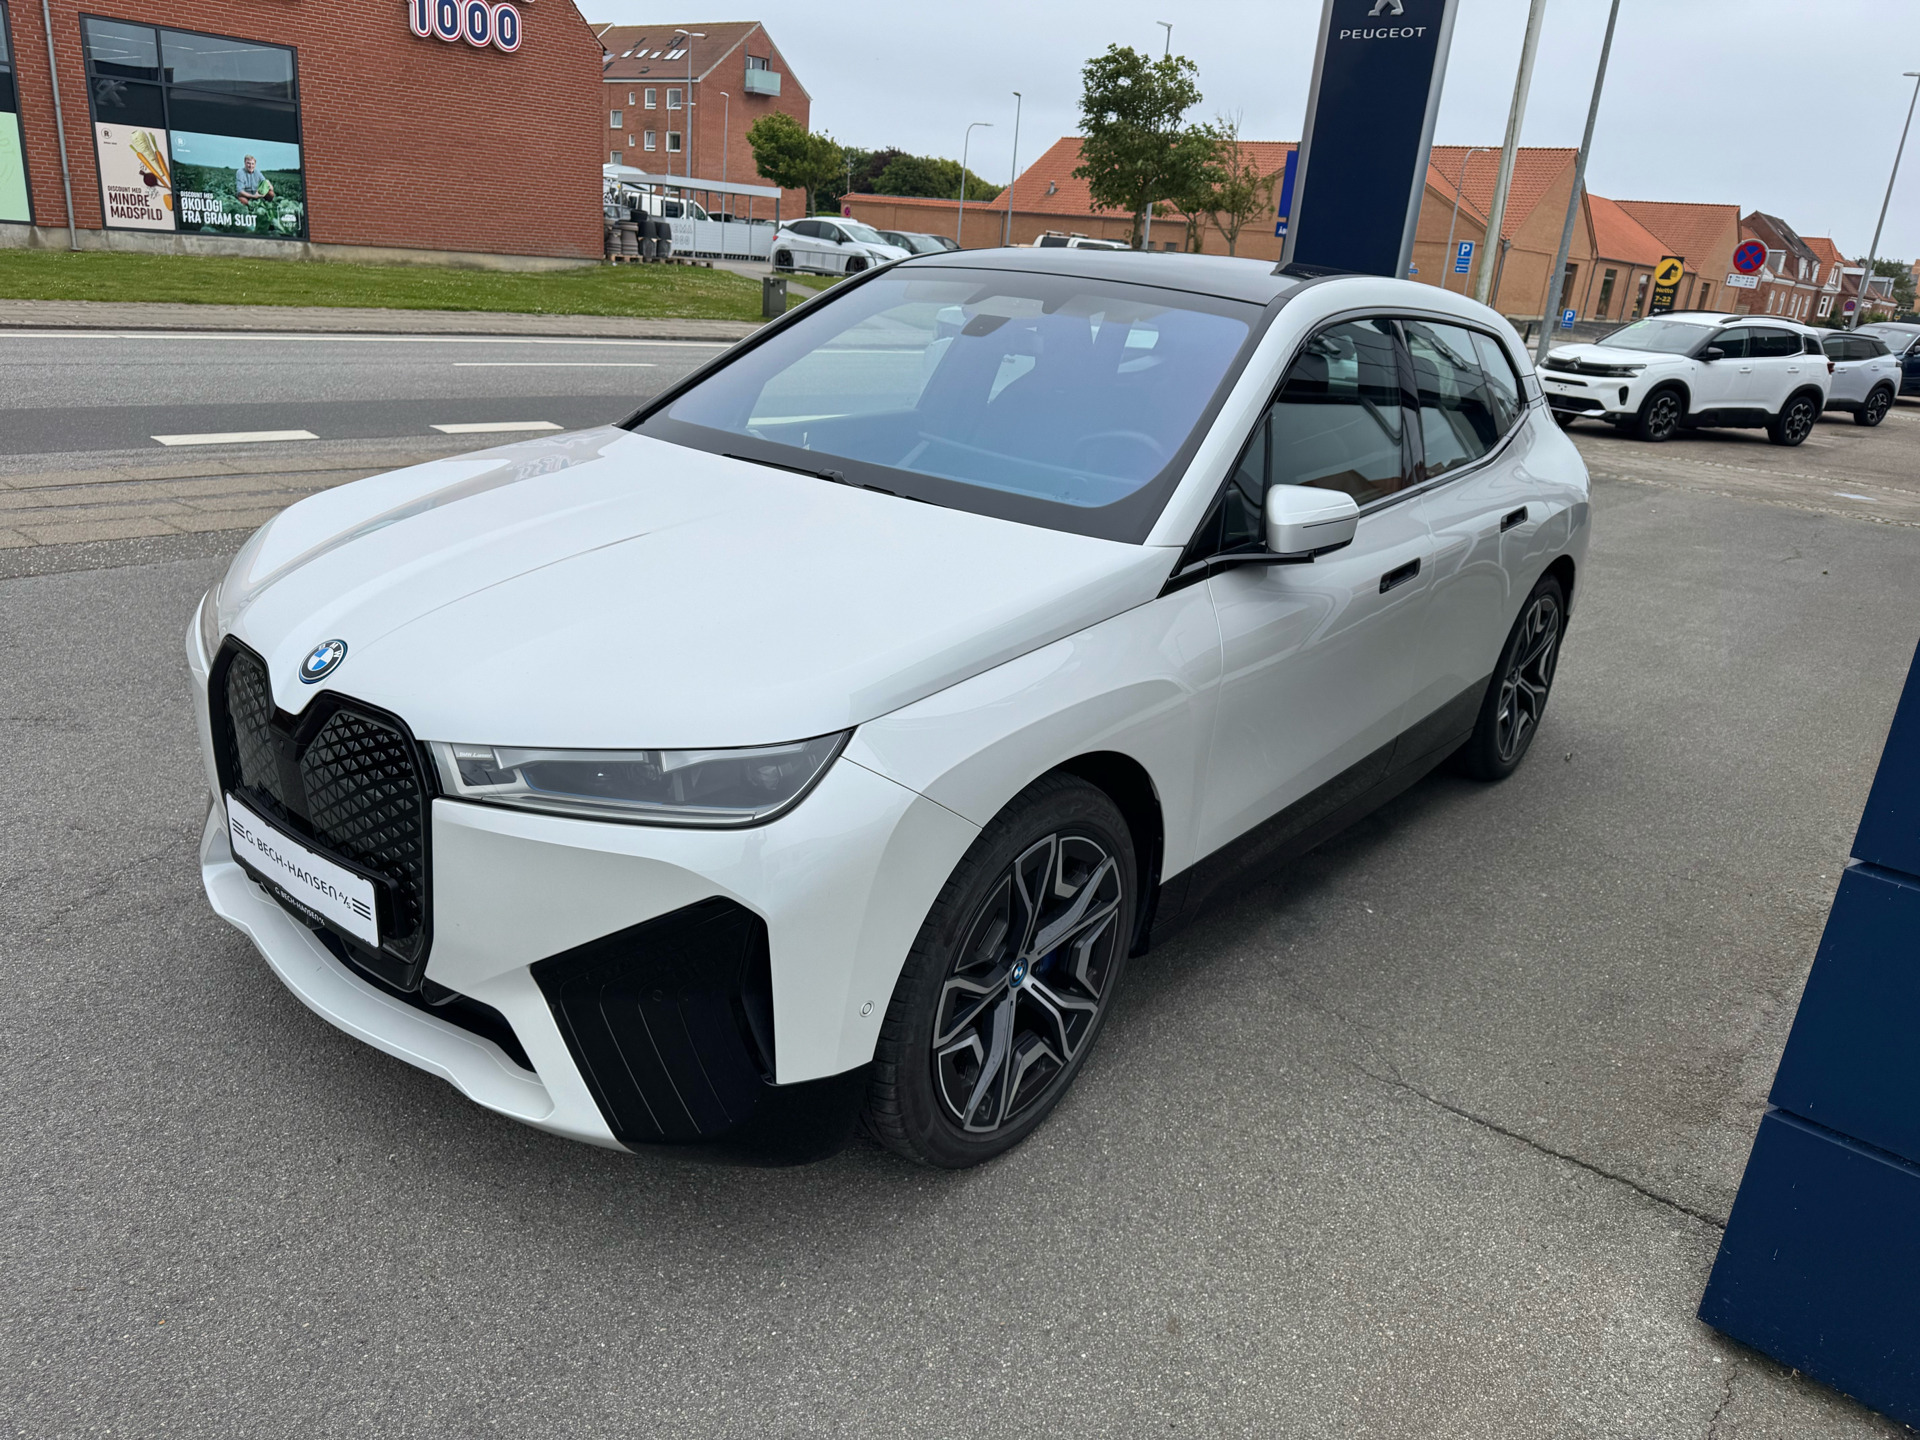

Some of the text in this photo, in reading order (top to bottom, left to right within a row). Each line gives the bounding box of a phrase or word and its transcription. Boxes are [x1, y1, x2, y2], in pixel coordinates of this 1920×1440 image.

[410, 0, 522, 53] 1000
[1339, 27, 1427, 40] PEUGEOT
[107, 185, 131, 193] DISCOUNT
[180, 190, 203, 199] DISCOUNT
[109, 193, 150, 207] MINDRE
[181, 198, 223, 212] ØKOLOGI
[110, 205, 163, 221] MADSPILD
[182, 210, 258, 228] FRA GRAM SLOT
[1461, 243, 1471, 256] P
[1565, 311, 1574, 321] P
[245, 830, 255, 846] G.
